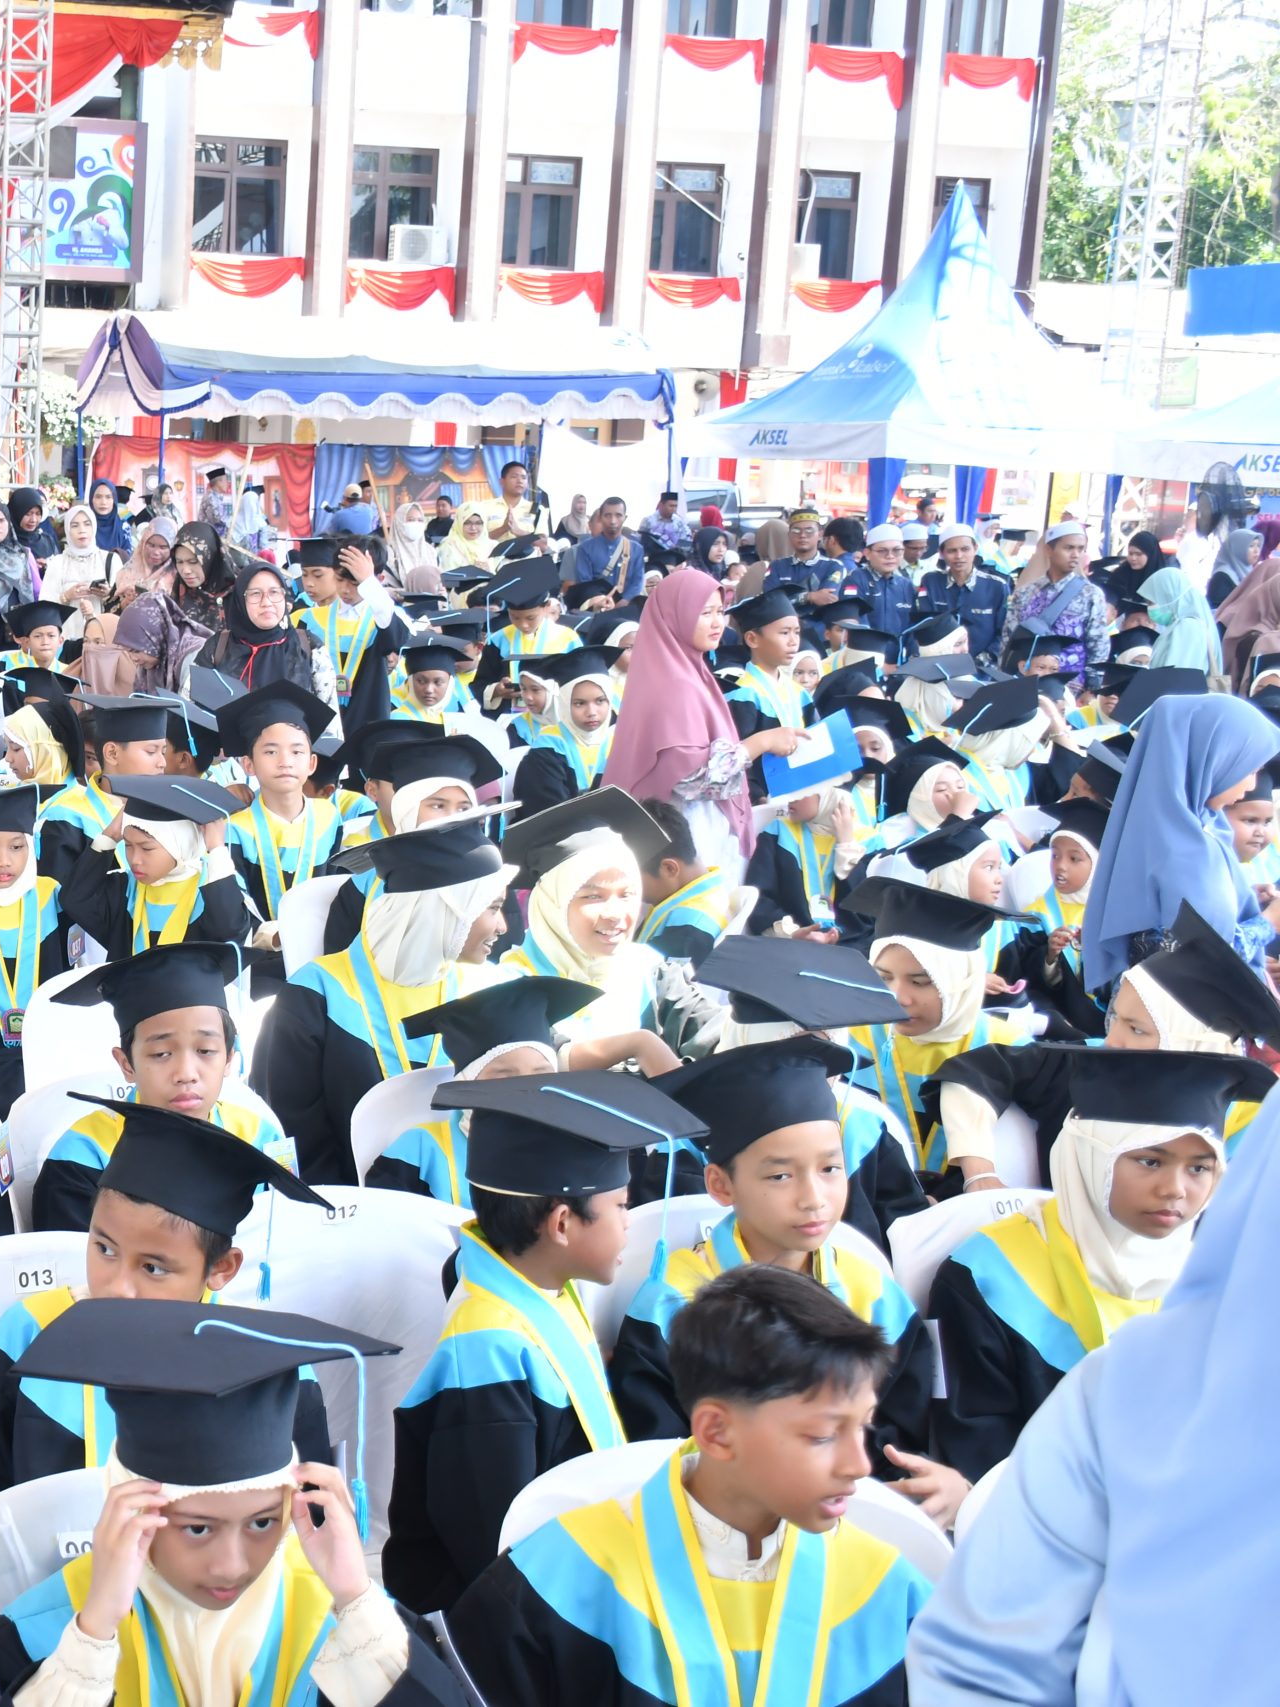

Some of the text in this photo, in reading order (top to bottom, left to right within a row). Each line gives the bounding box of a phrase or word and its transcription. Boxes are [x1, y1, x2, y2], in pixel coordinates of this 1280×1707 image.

[749, 429, 788, 447] AKSEL
[326, 1203, 358, 1221] 012
[18, 1268, 54, 1288] 013
